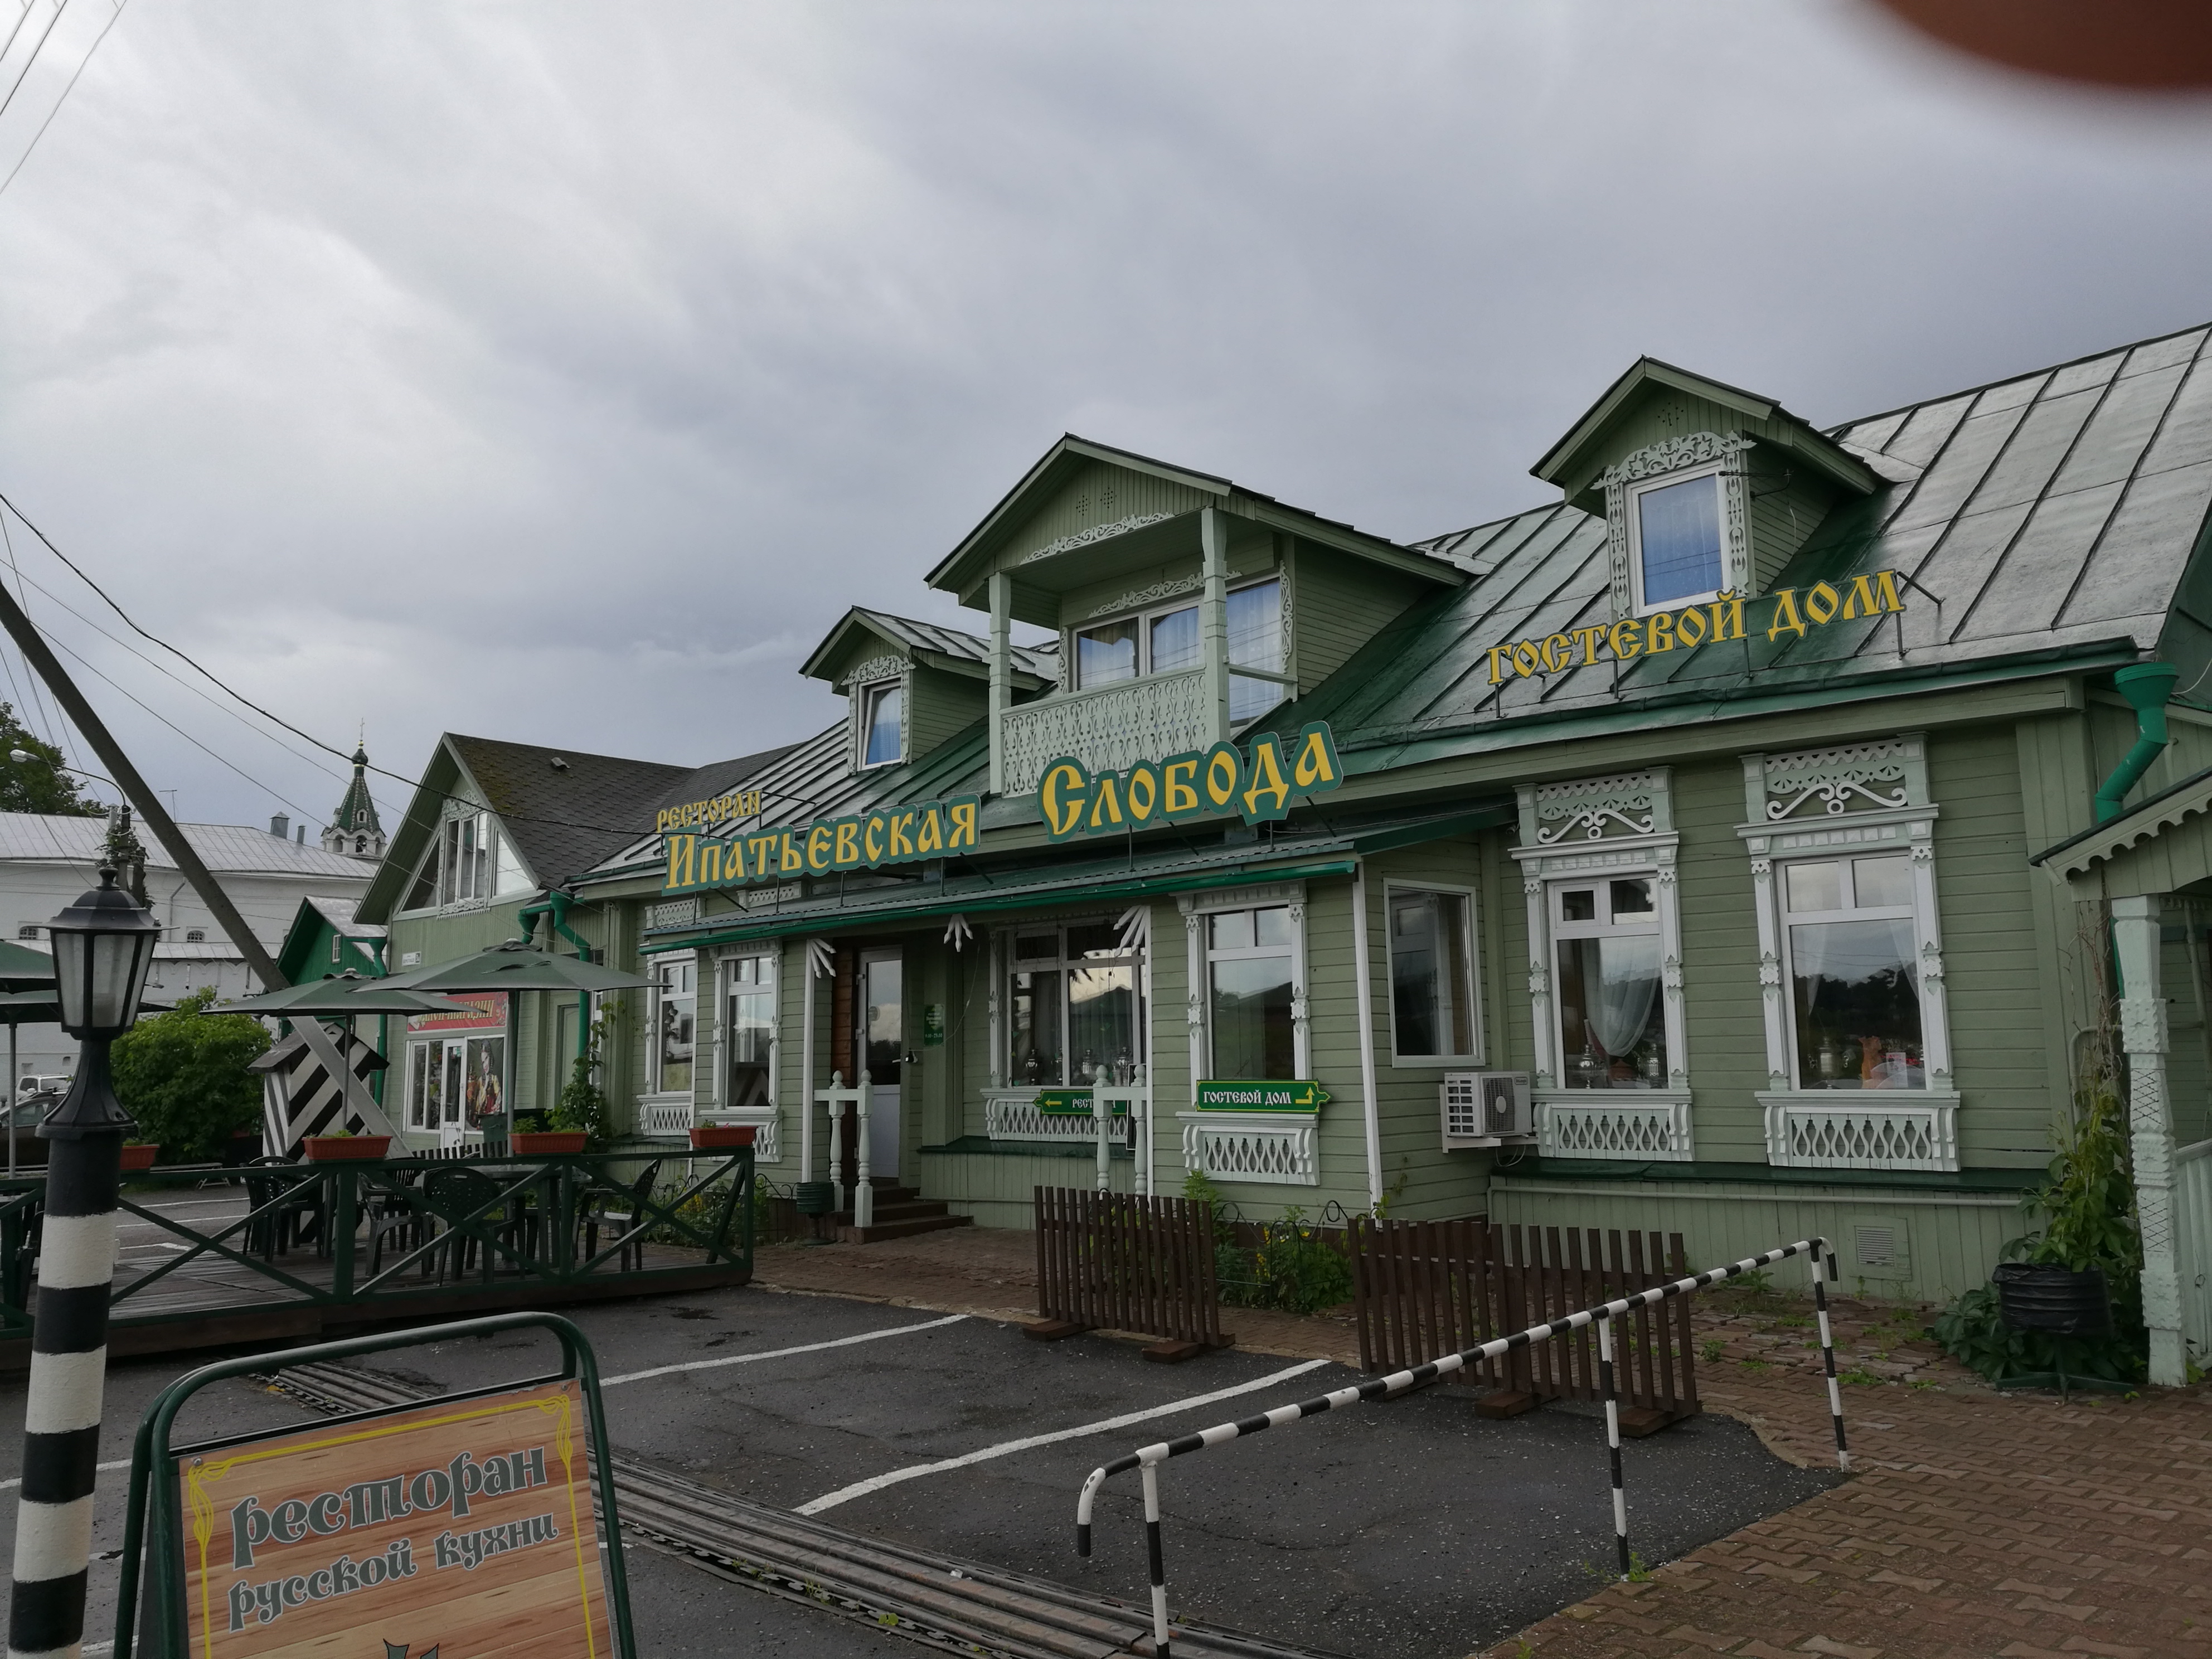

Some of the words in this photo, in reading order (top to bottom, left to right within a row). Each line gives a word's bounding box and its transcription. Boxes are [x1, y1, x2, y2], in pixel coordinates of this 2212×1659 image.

[1487, 589, 1748, 686] ГОСТЕВОЙ
[1766, 569, 1907, 643] ДОМ
[657, 789, 762, 833] РЕСТОРАН
[1203, 1089, 1262, 1104] ГОСТЕВОЙ
[1264, 1092, 1292, 1106] ДОМ
[230, 1446, 548, 1571] ресторан
[227, 1538, 418, 1633] русской
[433, 1512, 559, 1570] кухни
